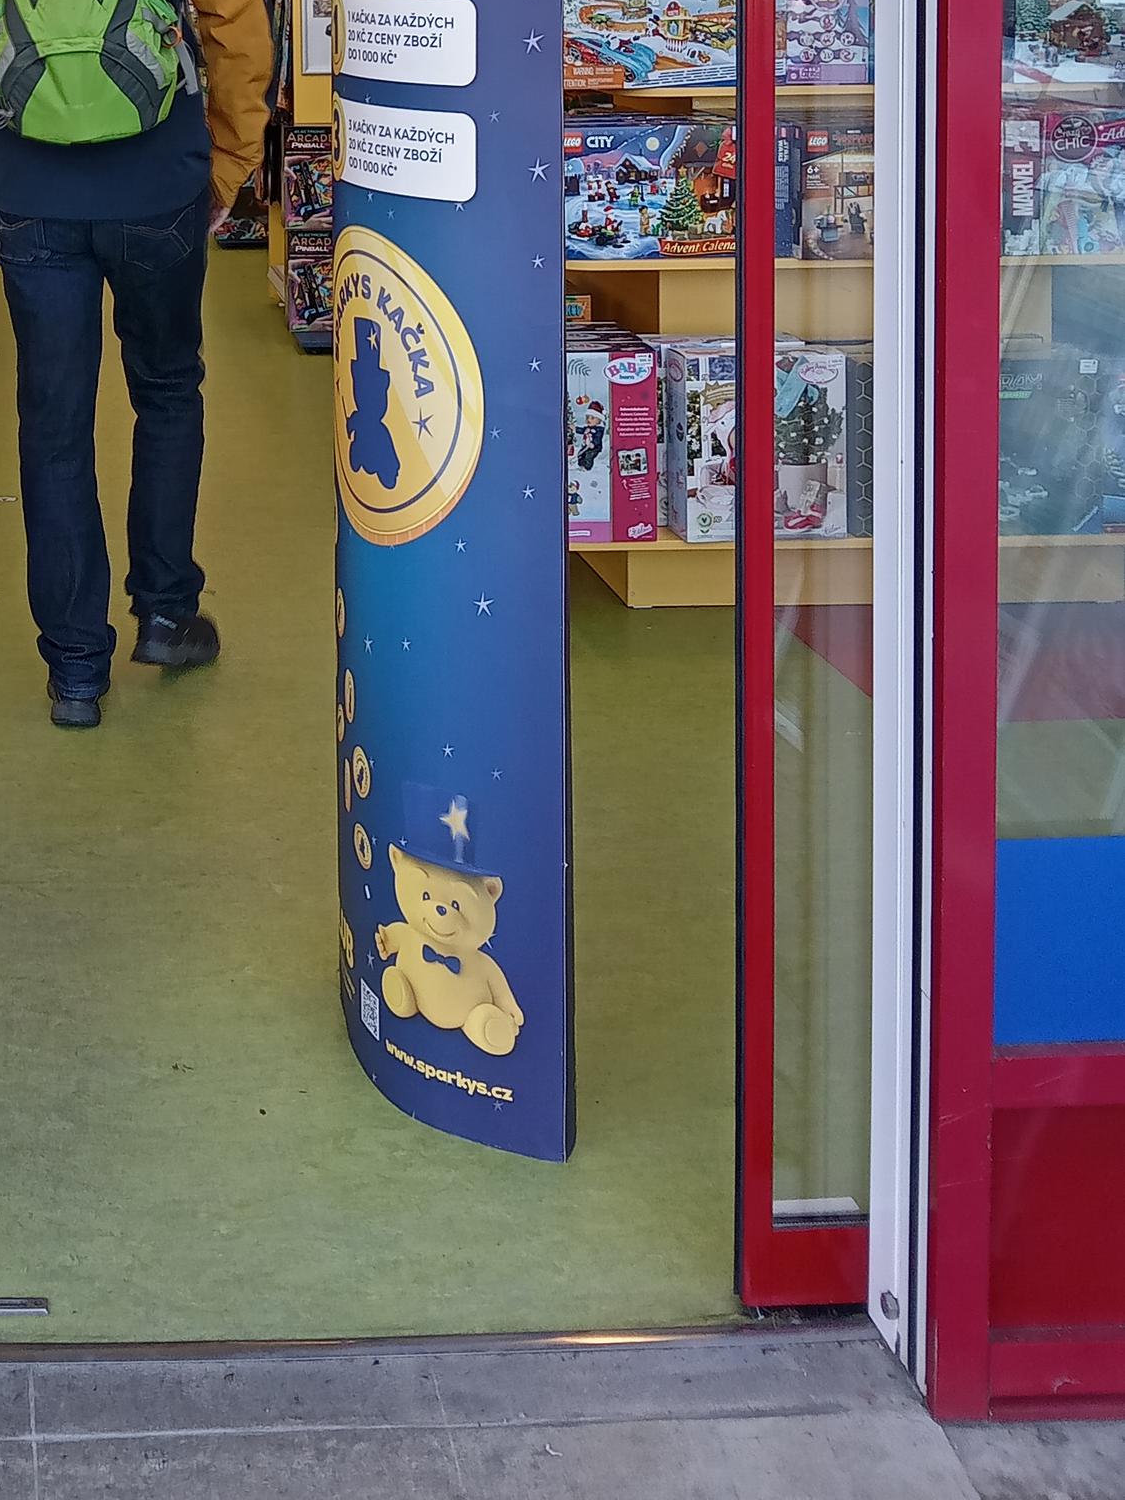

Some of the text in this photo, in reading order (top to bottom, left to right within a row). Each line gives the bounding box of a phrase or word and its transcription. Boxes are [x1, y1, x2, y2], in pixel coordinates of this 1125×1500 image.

[351, 9, 377, 25] KAČKA
[378, 14, 392, 26] ZA
[394, 13, 454, 29] KAŽDÝCH
[356, 28, 366, 43] KČ
[367, 32, 373, 44] Z
[375, 33, 401, 46] CENY
[404, 33, 443, 48] ZBOŽÍ
[353, 119, 377, 136] KAČKY
[378, 125, 392, 139] ZA
[394, 127, 455, 145] KAŽDÝCH
[586, 135, 615, 148] CITY
[809, 136, 828, 146] LEGO
[357, 138, 366, 153] KČ
[367, 142, 373, 154] Z
[375, 144, 401, 158] CENY
[404, 148, 443, 163] ZBOŽÍ
[1054, 137, 1091, 151] CHIC
[806, 165, 820, 175] 6+
[1012, 160, 1034, 217] MARVEL
[663, 242, 700, 253] Advent
[377, 286, 435, 399] KAČKA
[385, 1038, 514, 1102] www.sparkys.cz
